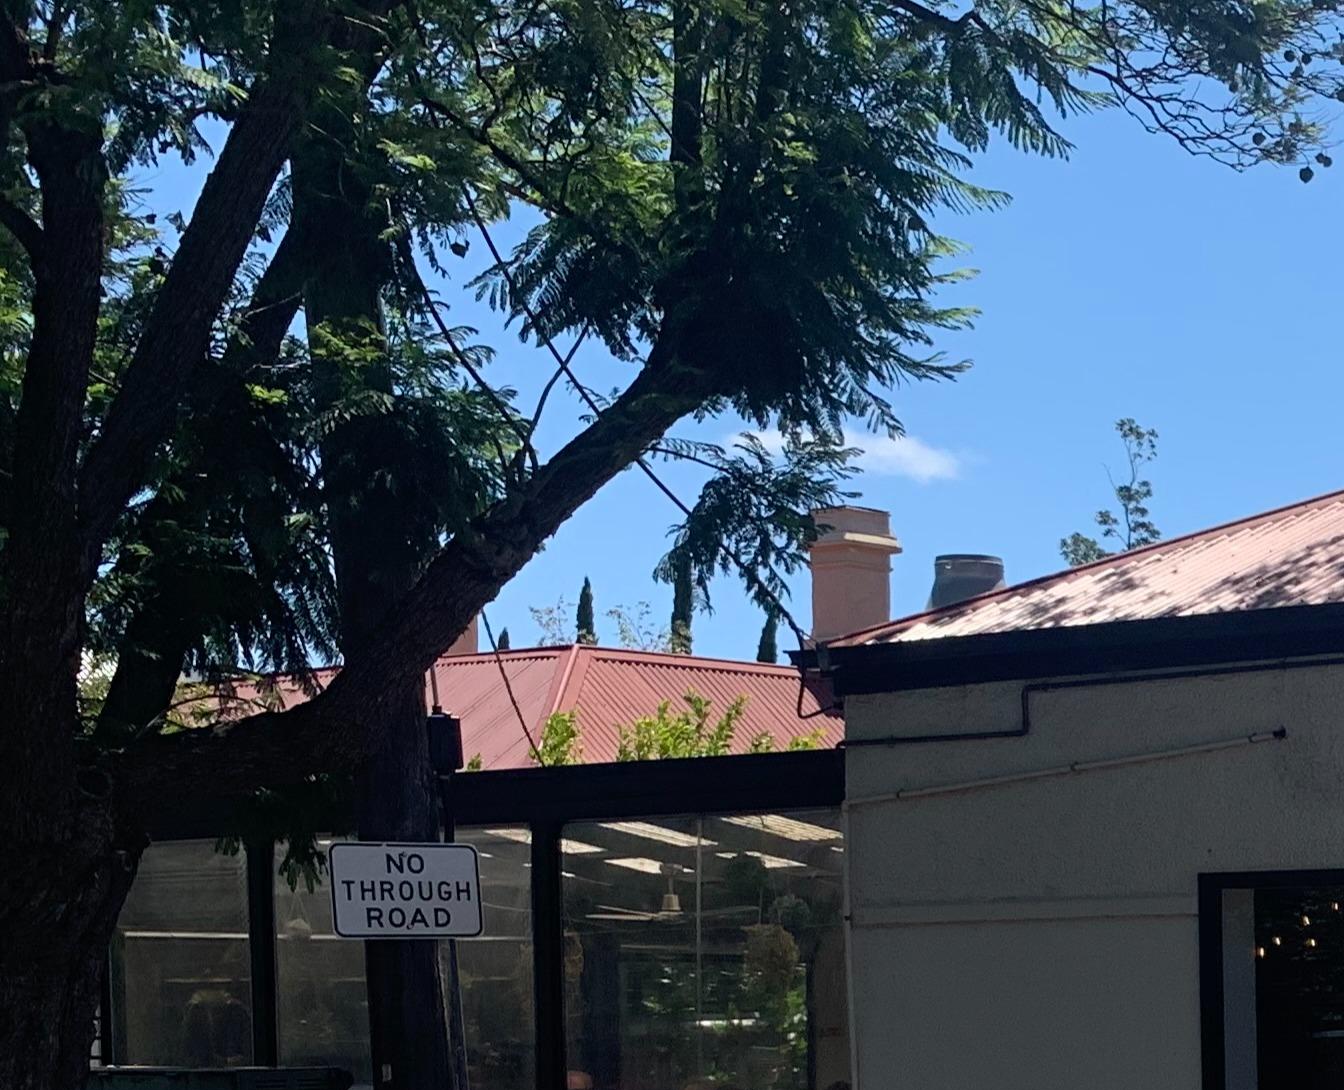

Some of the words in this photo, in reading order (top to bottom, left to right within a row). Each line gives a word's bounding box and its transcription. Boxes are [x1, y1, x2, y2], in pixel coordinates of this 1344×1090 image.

[385, 852, 425, 875] NO
[341, 880, 471, 902] THROUGH
[366, 907, 451, 928] ROAD
